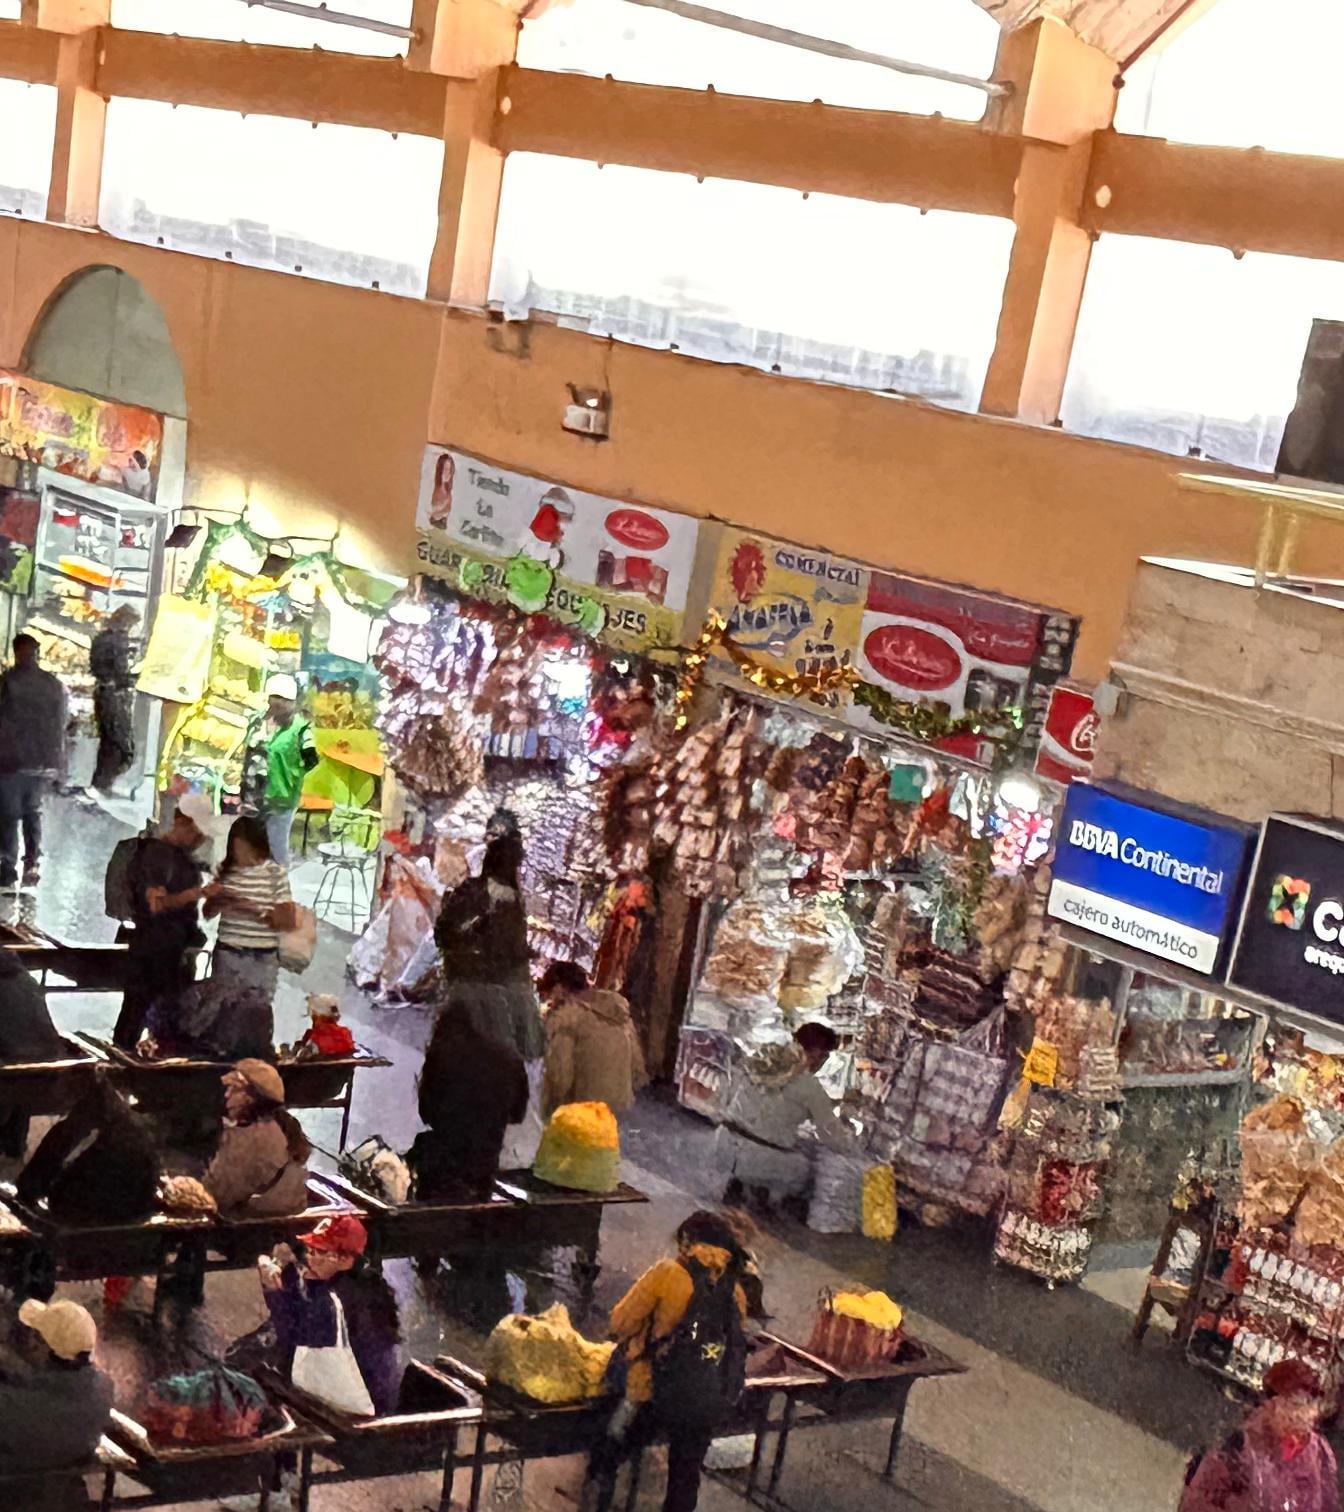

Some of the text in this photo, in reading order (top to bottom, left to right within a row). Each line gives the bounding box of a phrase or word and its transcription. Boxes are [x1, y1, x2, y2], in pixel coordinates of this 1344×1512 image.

[1069, 820, 1225, 894] BBVA Continental
[1062, 899, 1199, 960] cajero automático
